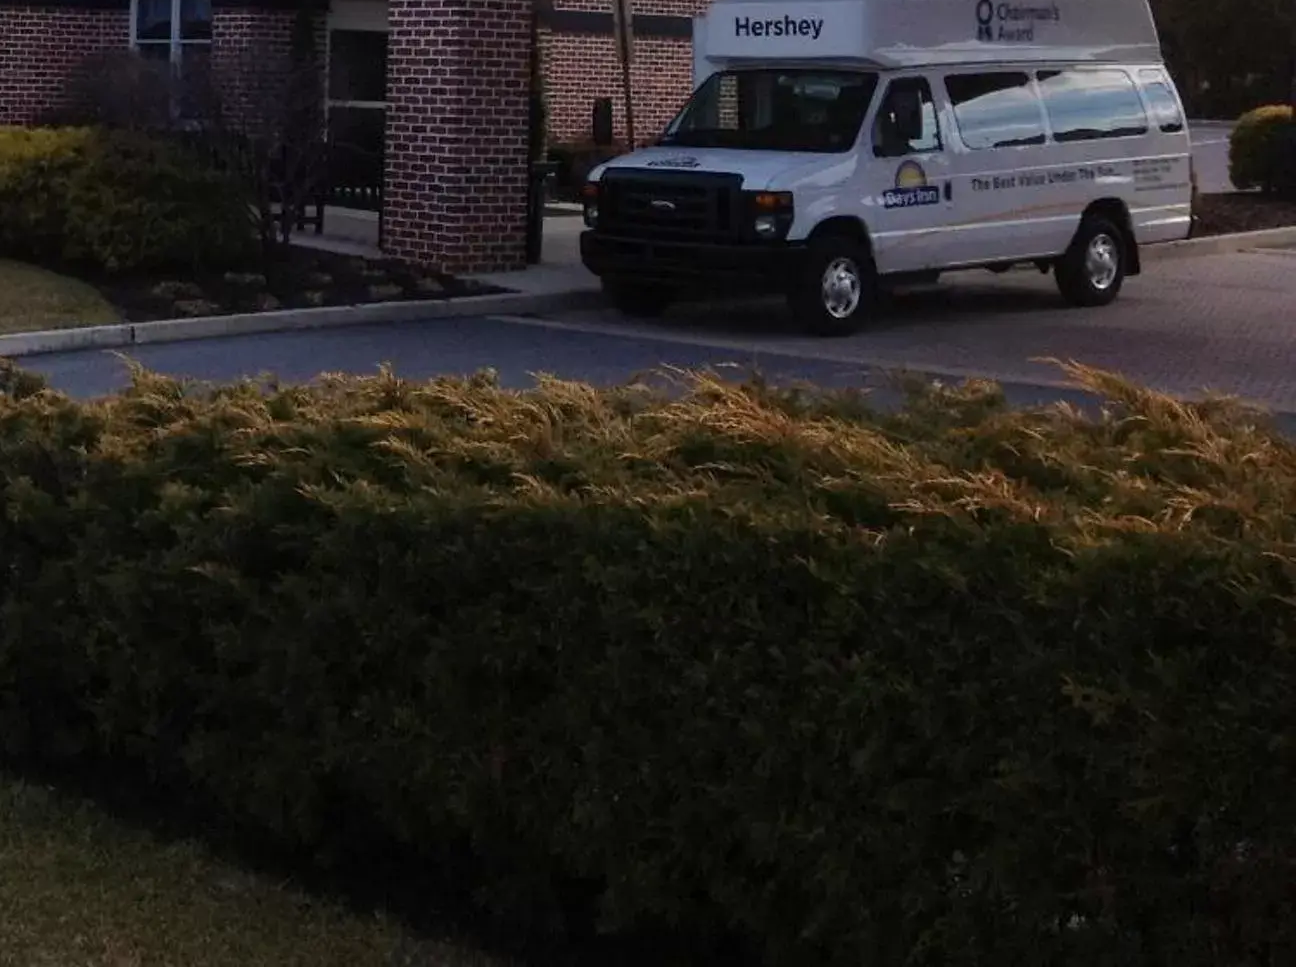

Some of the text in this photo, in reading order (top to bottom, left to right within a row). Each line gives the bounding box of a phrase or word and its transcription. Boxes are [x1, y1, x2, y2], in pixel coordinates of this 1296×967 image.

[735, 14, 823, 40] Hershey
[992, 176, 1016, 190] Best
[886, 188, 937, 207] Days Inn
